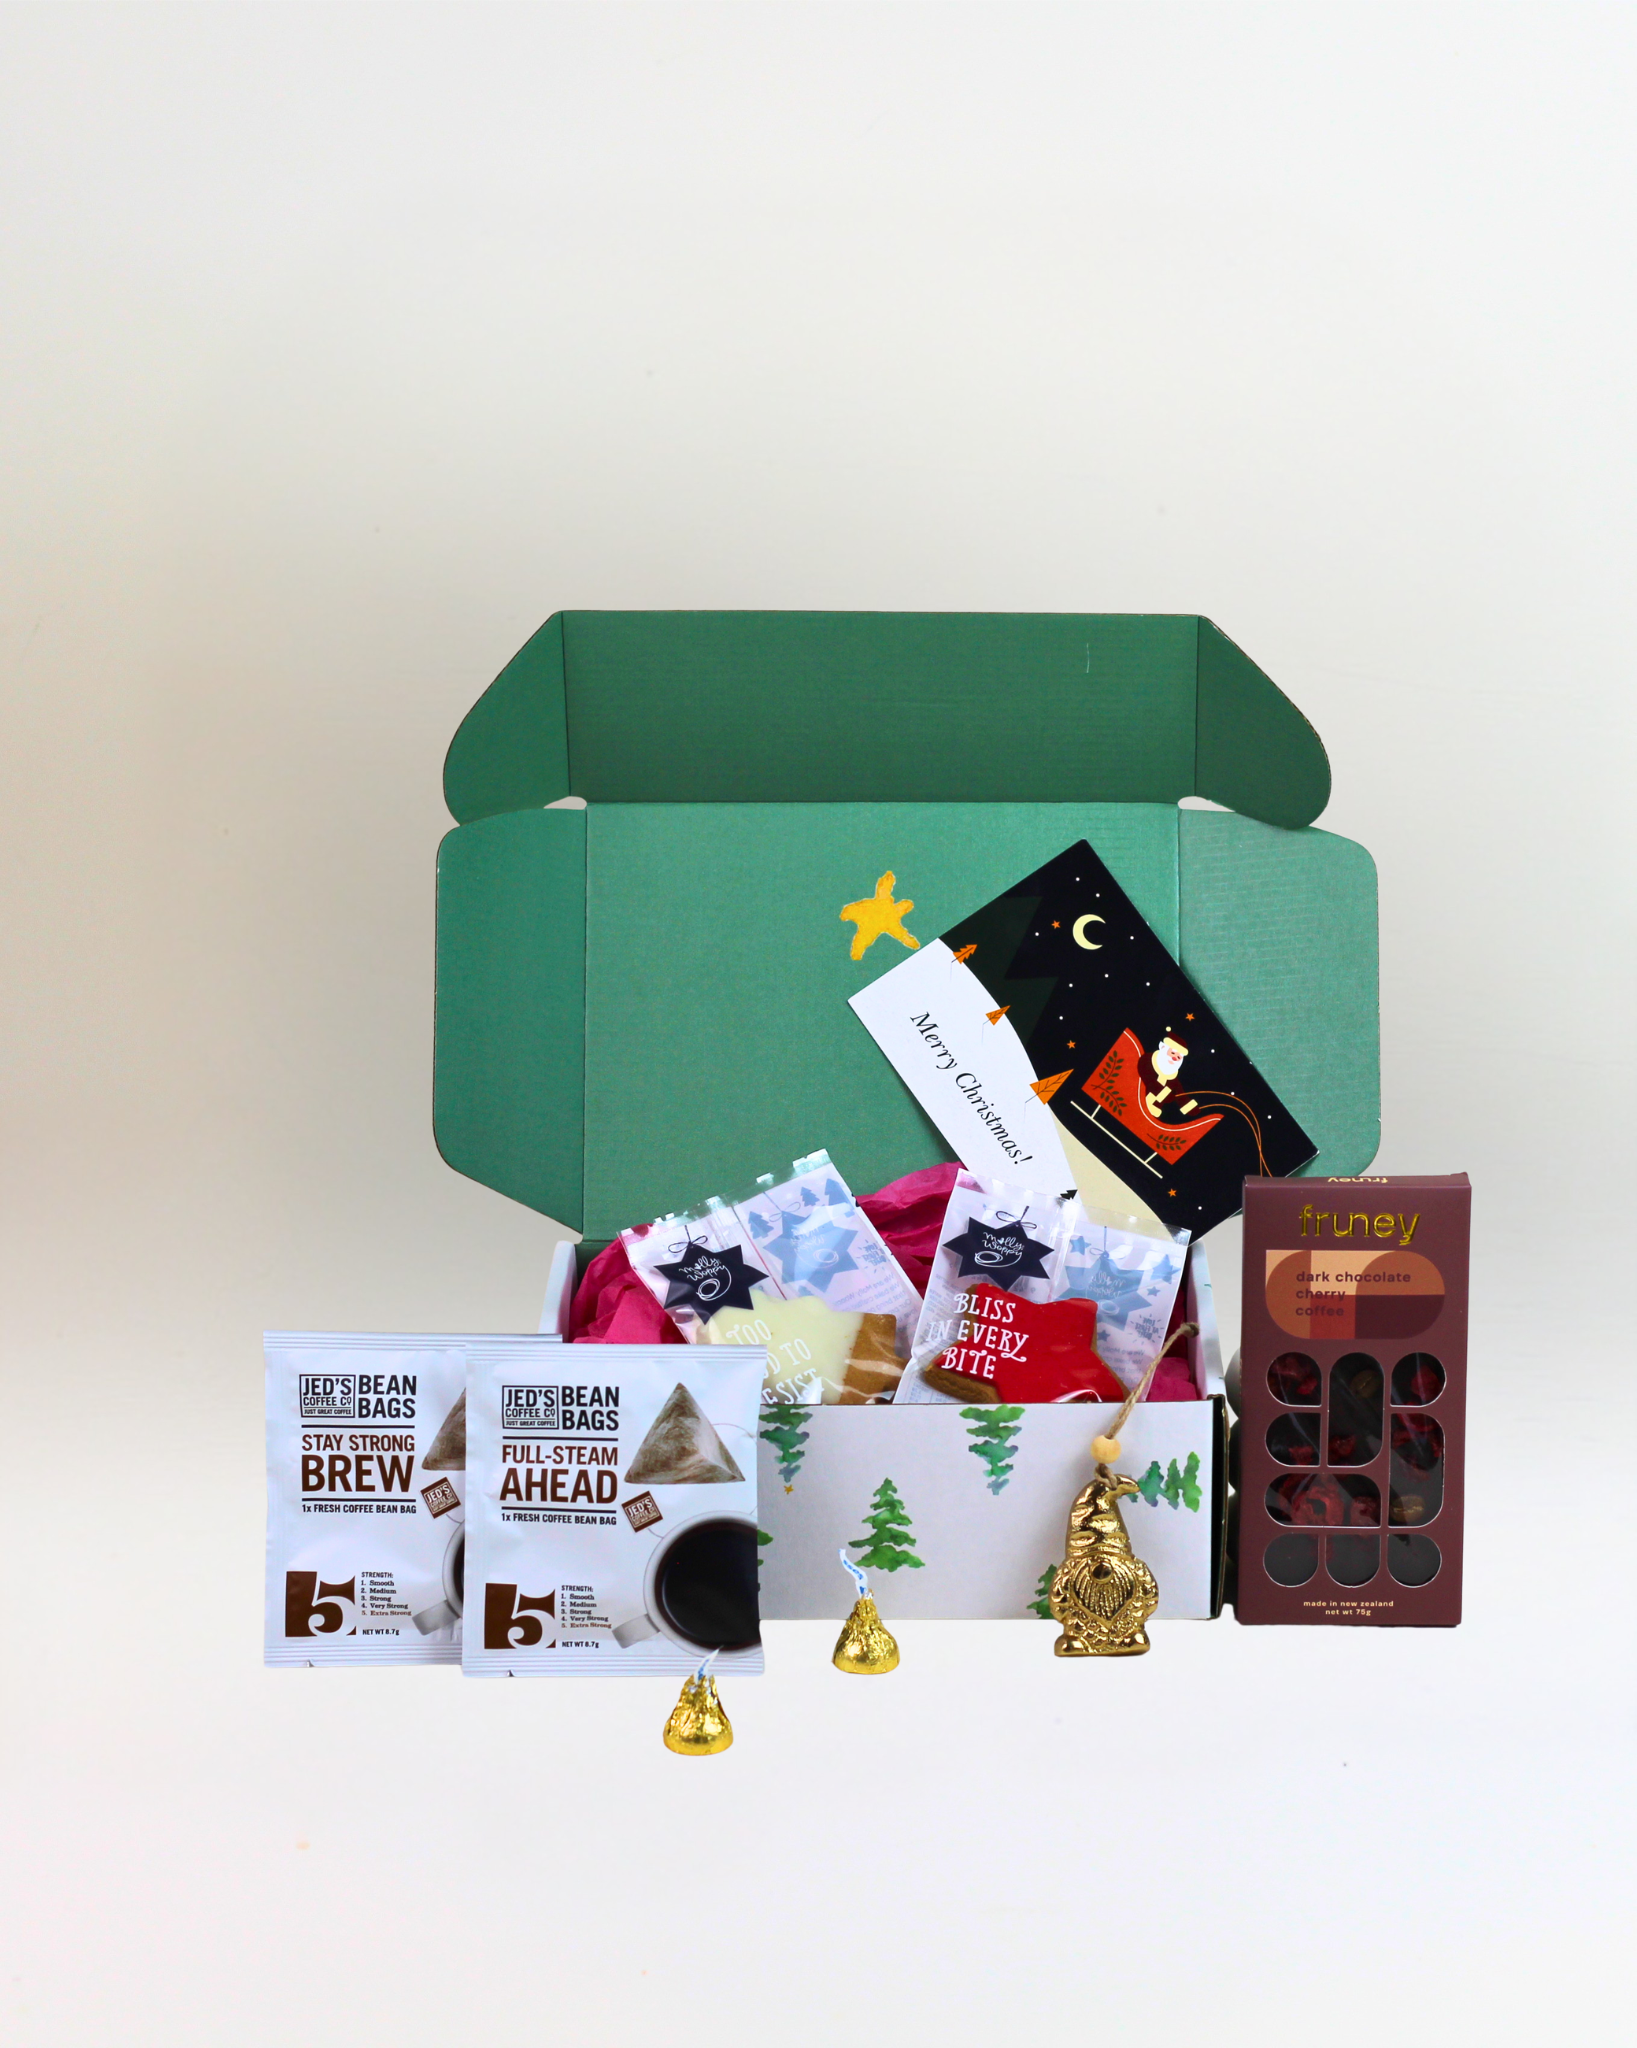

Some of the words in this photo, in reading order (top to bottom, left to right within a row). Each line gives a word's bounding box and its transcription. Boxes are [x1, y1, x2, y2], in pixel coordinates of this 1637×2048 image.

[910, 1011, 958, 1070] Merry
[955, 1072, 1033, 1165] Christmas!
[1299, 1204, 1420, 1246] fruney
[1296, 1271, 1330, 1283] dark
[1335, 1271, 1411, 1283] chocolate
[1296, 1289, 1346, 1301] cherry
[954, 1292, 1016, 1323] BLISS
[1295, 1305, 1345, 1317] coffee
[726, 1319, 772, 1345] TOO
[926, 1319, 953, 1341] IN
[957, 1320, 1029, 1362] EVERY
[779, 1338, 811, 1366] TO
[941, 1346, 997, 1379] BITE
[303, 1378, 352, 1396] JED'S
[358, 1374, 417, 1396] BEAN
[303, 1396, 337, 1406] COFFEE
[505, 1389, 555, 1408] JED'S
[561, 1385, 620, 1408] BEAN
[358, 1397, 416, 1419] BAGS
[505, 1408, 541, 1418] COFFEE
[562, 1409, 619, 1431] BAGS
[302, 1434, 344, 1451] STAY
[349, 1434, 415, 1452] STRONG
[502, 1444, 618, 1466] FULL-STEAM
[301, 1454, 415, 1493] BREW
[427, 1485, 450, 1503] JED'S
[499, 1467, 618, 1504] AHEAD
[302, 1504, 312, 1513] 1x
[313, 1504, 341, 1514] FRESH
[343, 1504, 374, 1514] COFFEE
[375, 1504, 398, 1514] BEAN
[400, 1505, 417, 1514] BAG
[628, 1498, 652, 1516] JED'S
[501, 1513, 511, 1522] 1x
[513, 1513, 540, 1523] FRESH
[542, 1514, 572, 1524] COFFEE
[575, 1515, 597, 1524] BEAN
[599, 1516, 617, 1525] BAG
[300, 1571, 357, 1637] 5
[500, 1583, 556, 1649] 5
[585, 1641, 599, 1649] 8.7g
